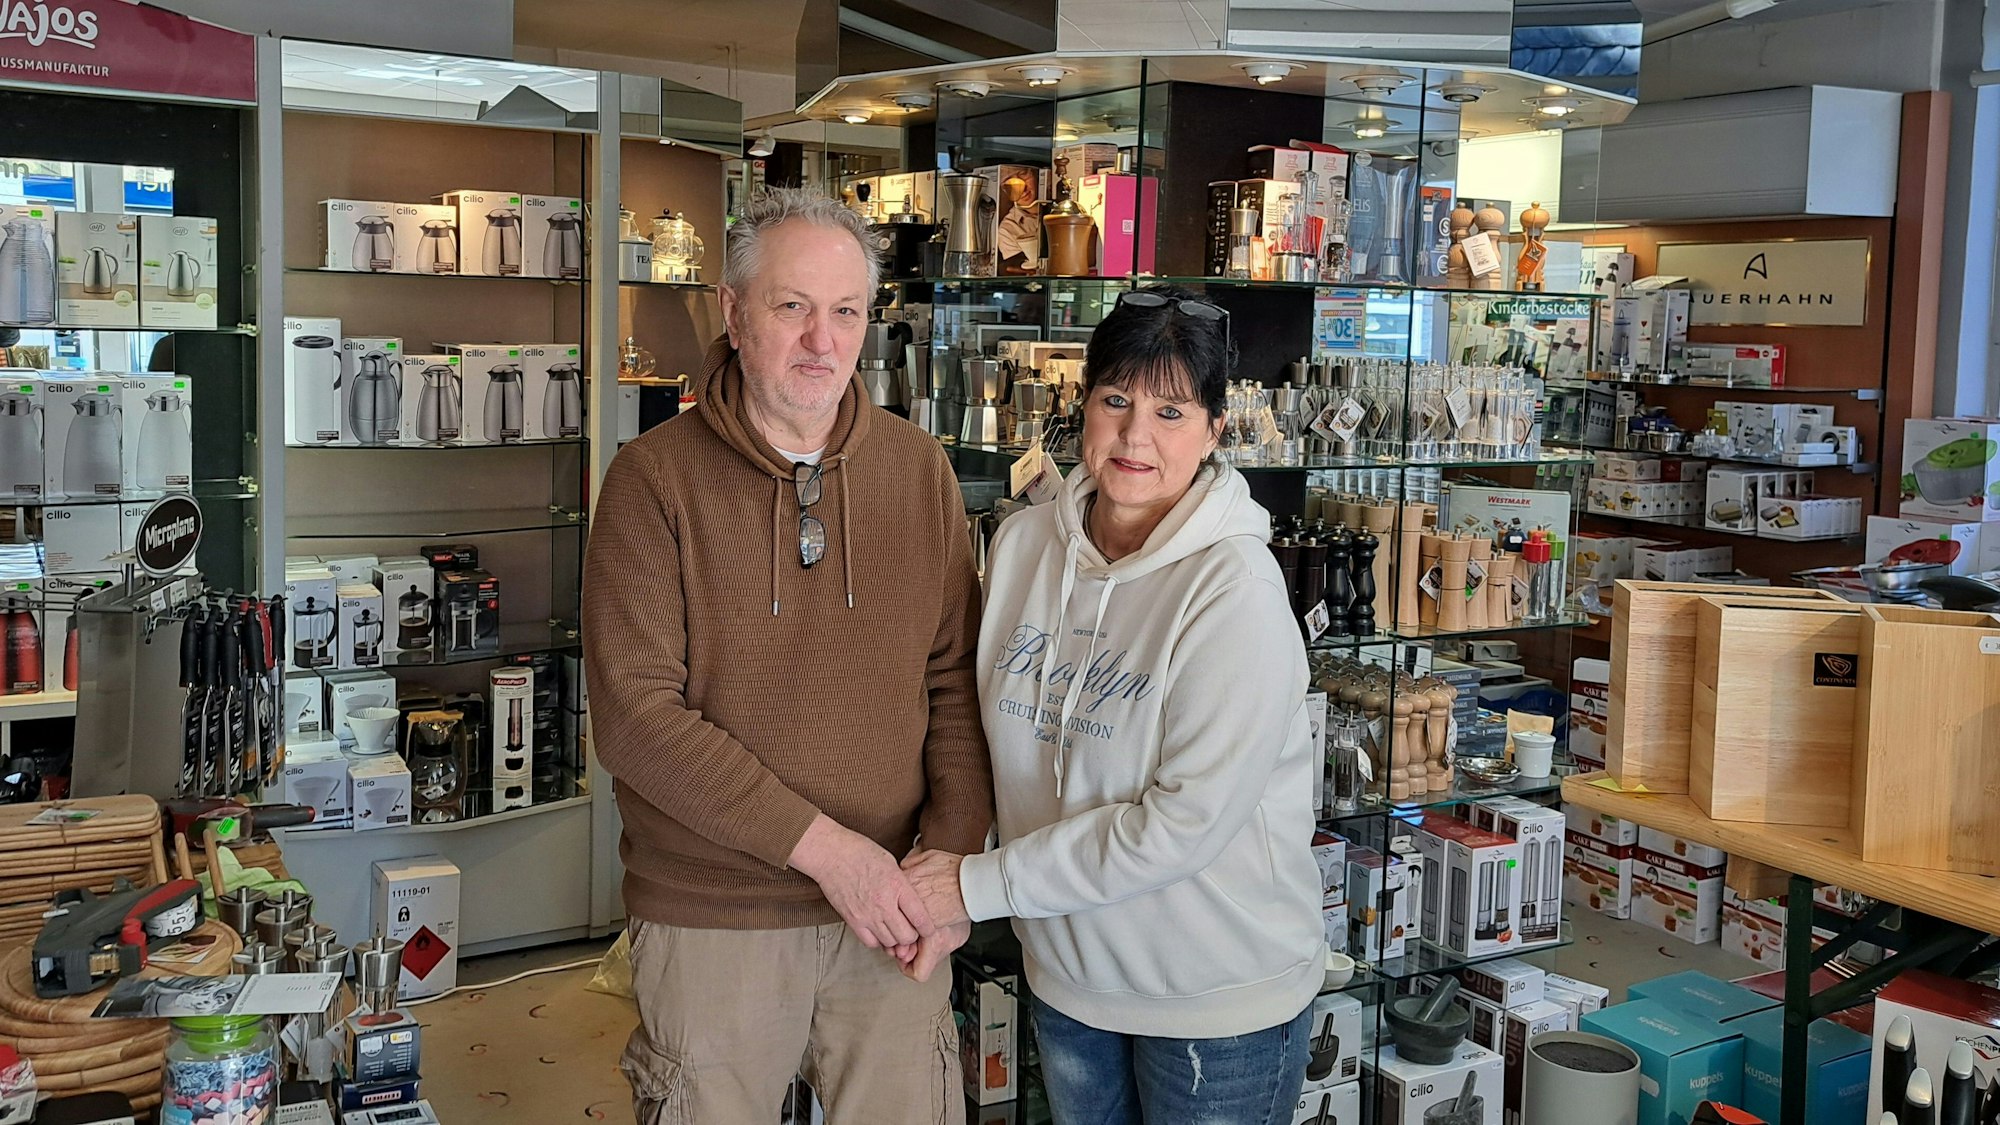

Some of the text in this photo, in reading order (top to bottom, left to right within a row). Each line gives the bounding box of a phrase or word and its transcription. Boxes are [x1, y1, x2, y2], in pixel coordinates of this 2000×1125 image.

[1487, 299, 1590, 317] Kinderbestecke
[48, 383, 73, 394] cilio
[122, 380, 146, 390] cilio
[1487, 495, 1532, 507] WESTMARK
[46, 508, 71, 520] cilio
[993, 622, 1156, 713] Broklyn
[1522, 823, 1544, 835] cilio
[1572, 834, 1590, 847] CAKE
[1645, 853, 1665, 866] CAKE
[1509, 982, 1526, 994] cilio
[1531, 1022, 1550, 1035] cilio
[1689, 1071, 1724, 1089] kuppels
[1744, 1063, 1782, 1089] kuppel
[1410, 1082, 1434, 1098] cilio
